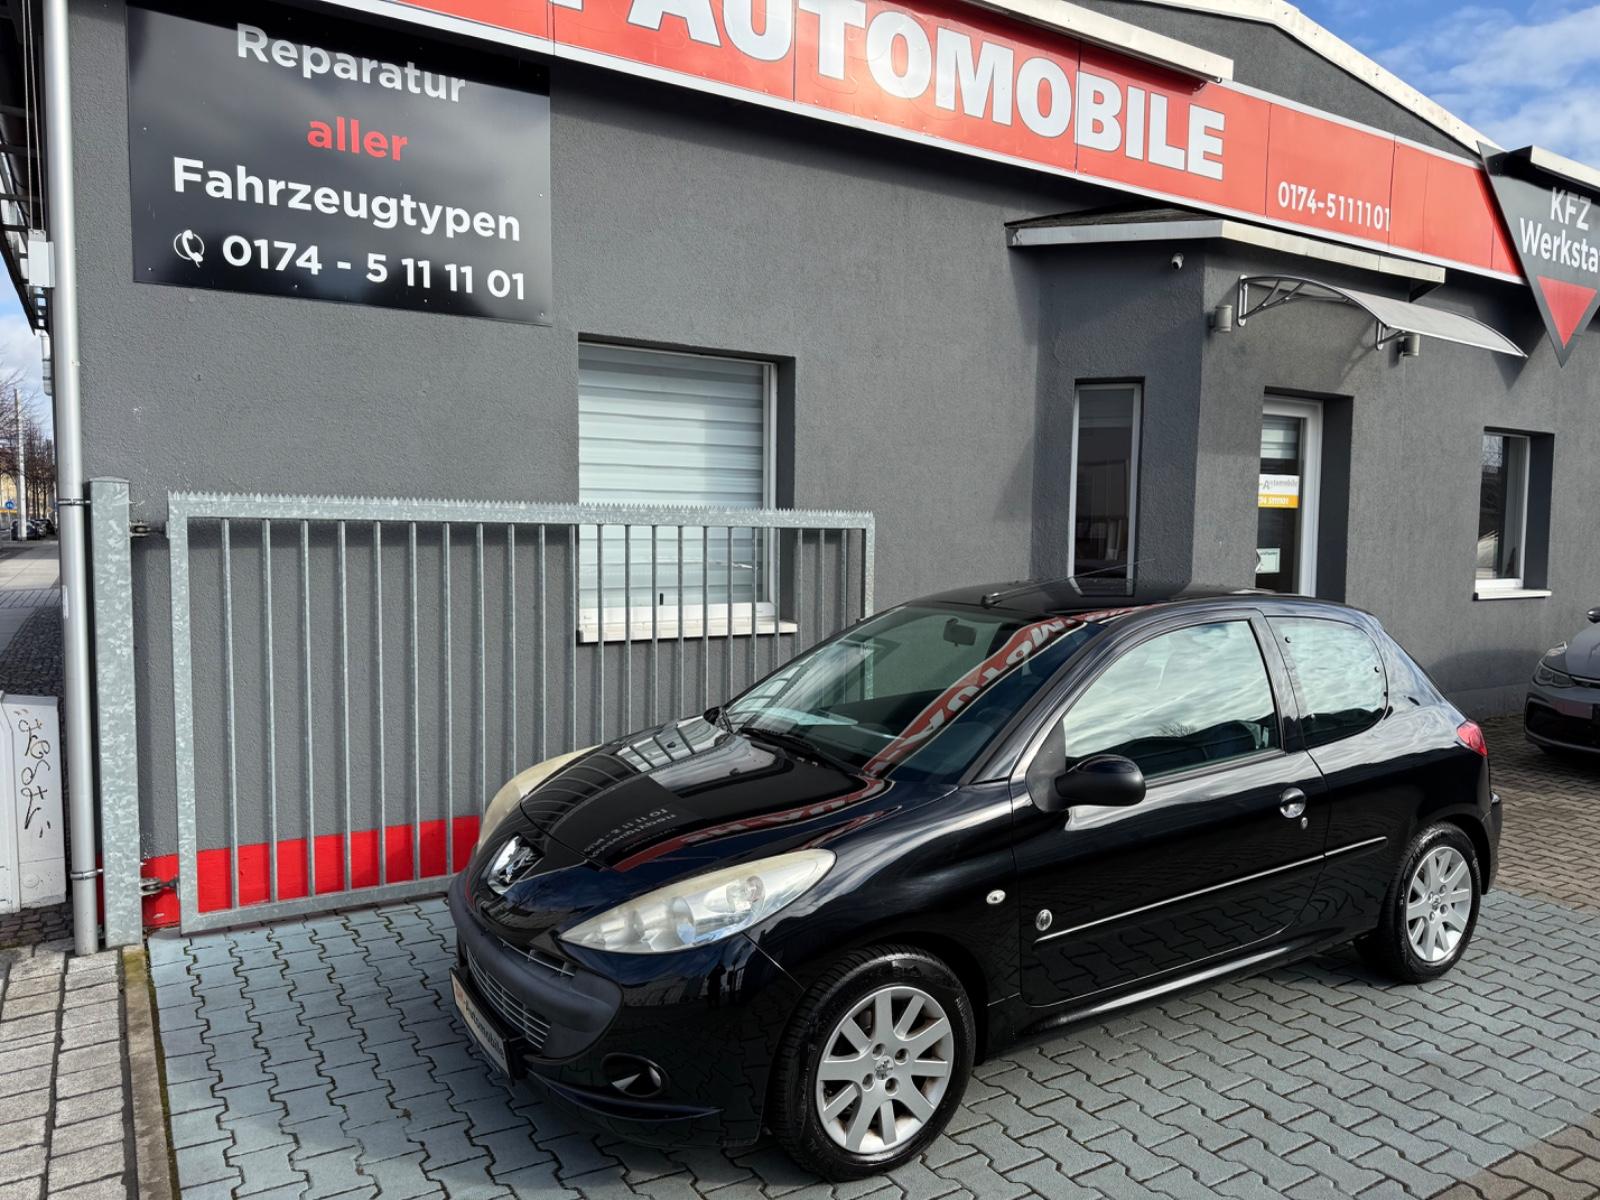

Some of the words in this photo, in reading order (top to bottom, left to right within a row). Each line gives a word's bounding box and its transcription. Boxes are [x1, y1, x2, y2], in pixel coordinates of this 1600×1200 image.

[236, 22, 466, 102] Reparatur
[307, 116, 409, 161] aller
[173, 156, 521, 242] Fahrzeugtypen
[1278, 180, 1390, 232] 0174-5111101
[1550, 186, 1592, 231] KFZ
[222, 235, 323, 276] 0174
[366, 253, 388, 283] 5
[401, 258, 431, 289] 11
[444, 264, 474, 294] 11
[487, 269, 525, 300] 01
[1520, 217, 1600, 273] Werksta
